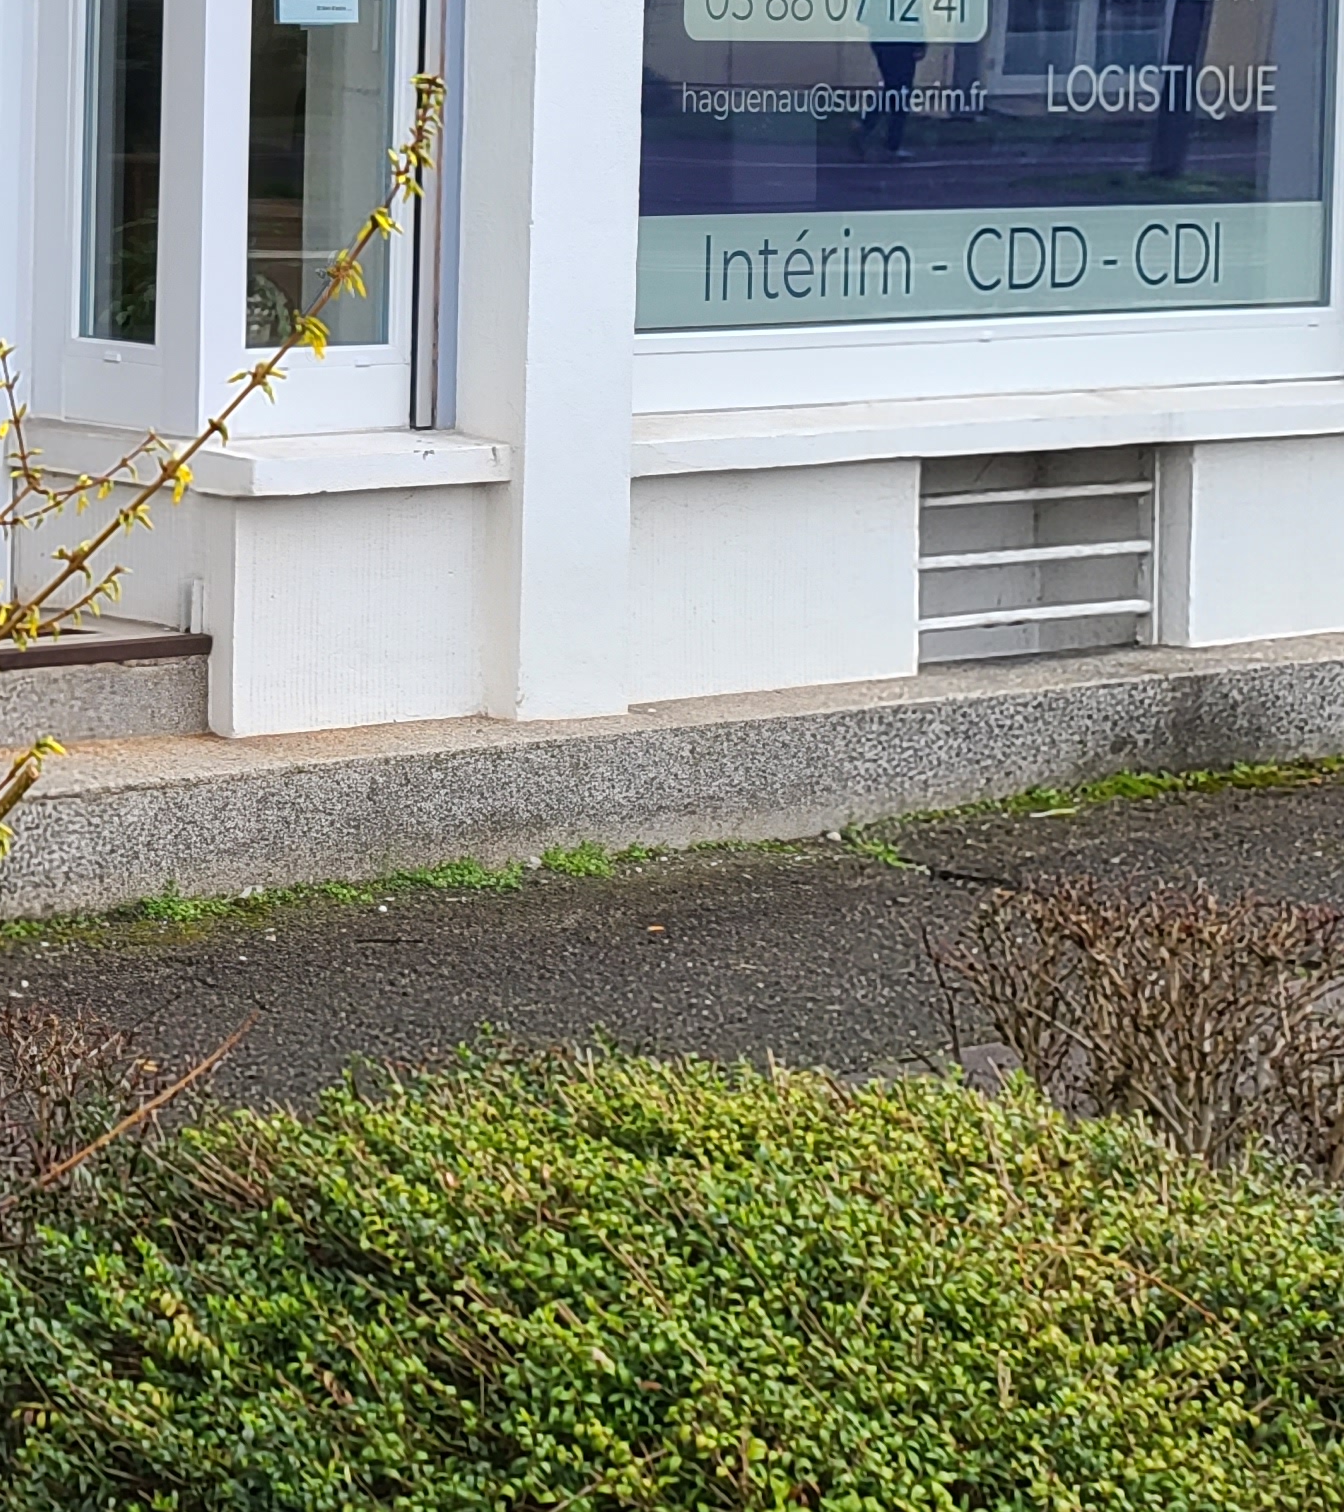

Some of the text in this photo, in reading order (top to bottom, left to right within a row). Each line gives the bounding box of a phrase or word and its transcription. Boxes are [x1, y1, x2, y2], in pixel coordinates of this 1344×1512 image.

[681, 81, 988, 120] haguenau@supinterim.fr
[1046, 63, 1279, 120] LOGISTIQUE
[704, 228, 911, 302] Intérim
[966, 226, 1088, 292] CDD
[1135, 221, 1221, 286] CDI
